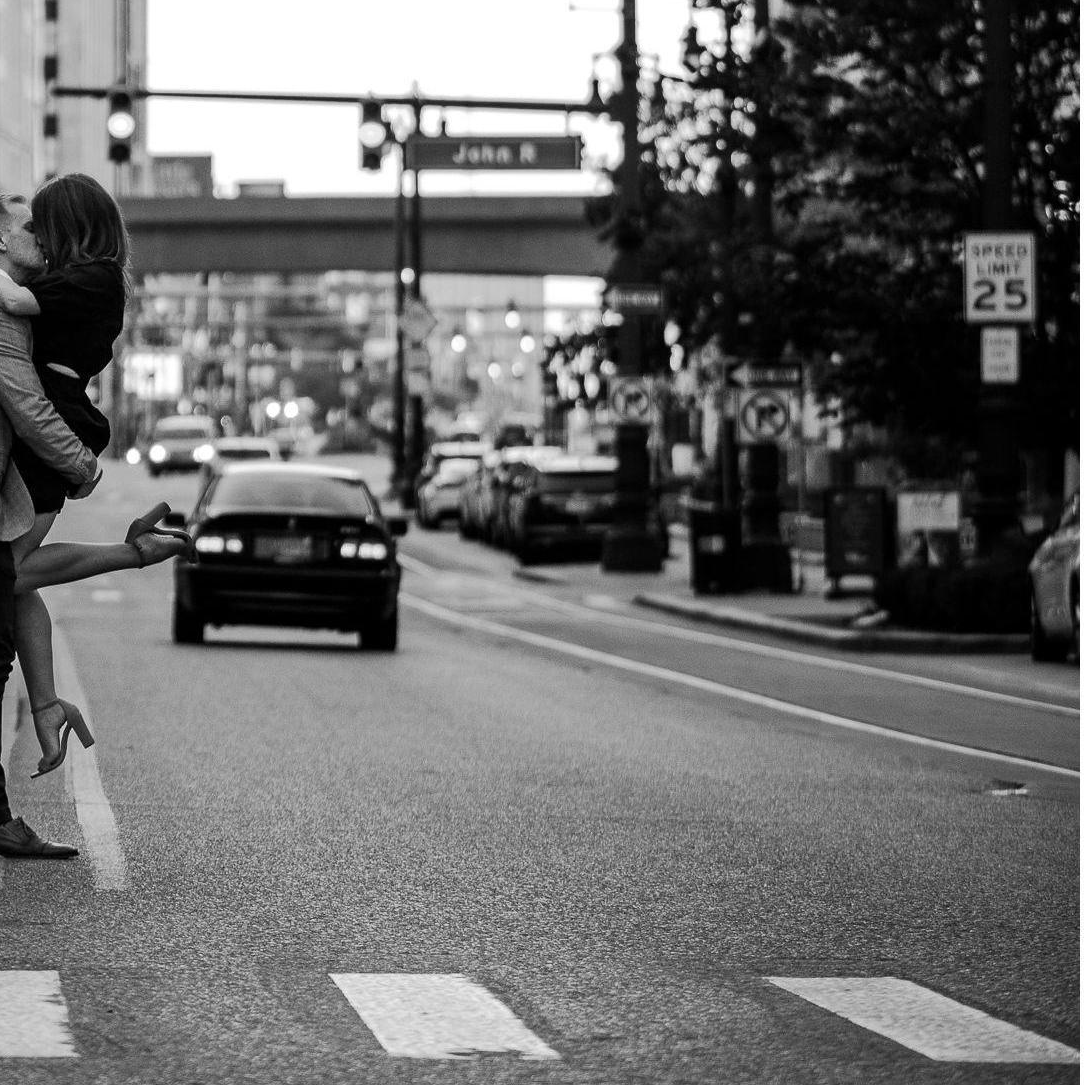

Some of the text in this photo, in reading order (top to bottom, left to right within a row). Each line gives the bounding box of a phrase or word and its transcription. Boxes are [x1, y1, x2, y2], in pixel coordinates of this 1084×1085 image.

[452, 141, 538, 165] John R
[971, 244, 1028, 258] SPEED
[976, 262, 1021, 276] LIMIT
[973, 279, 1027, 310] 25
